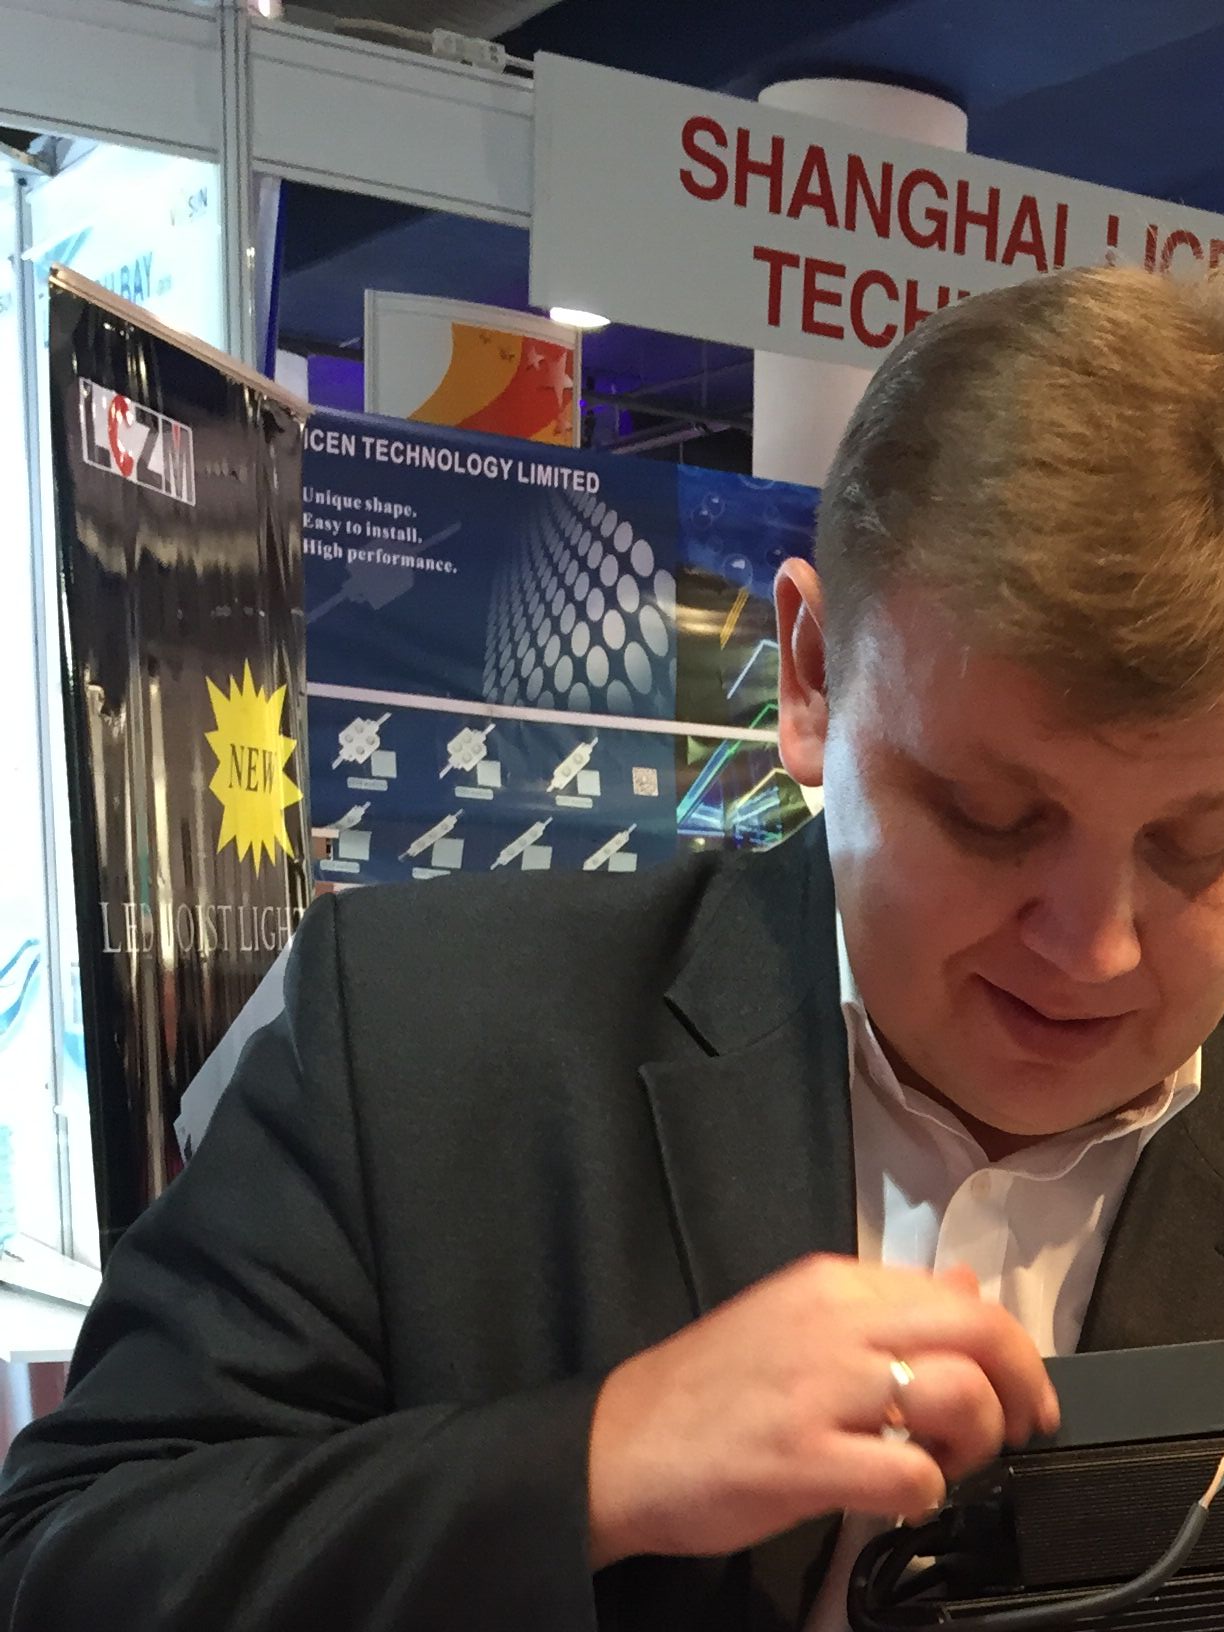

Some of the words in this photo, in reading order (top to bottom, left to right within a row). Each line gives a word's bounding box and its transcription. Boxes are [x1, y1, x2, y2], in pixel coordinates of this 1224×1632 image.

[680, 116, 1069, 271] SHANGHAI
[361, 437, 513, 480] TECHNOLOGY
[517, 462, 600, 494] LIMITED
[303, 486, 362, 511] Unique
[365, 496, 417, 519] shape.
[303, 512, 341, 536] Easy
[346, 520, 362, 535] to
[366, 521, 423, 544] install.
[303, 538, 343, 562] High
[347, 547, 458, 574] performance.
[228, 743, 277, 794] NEW
